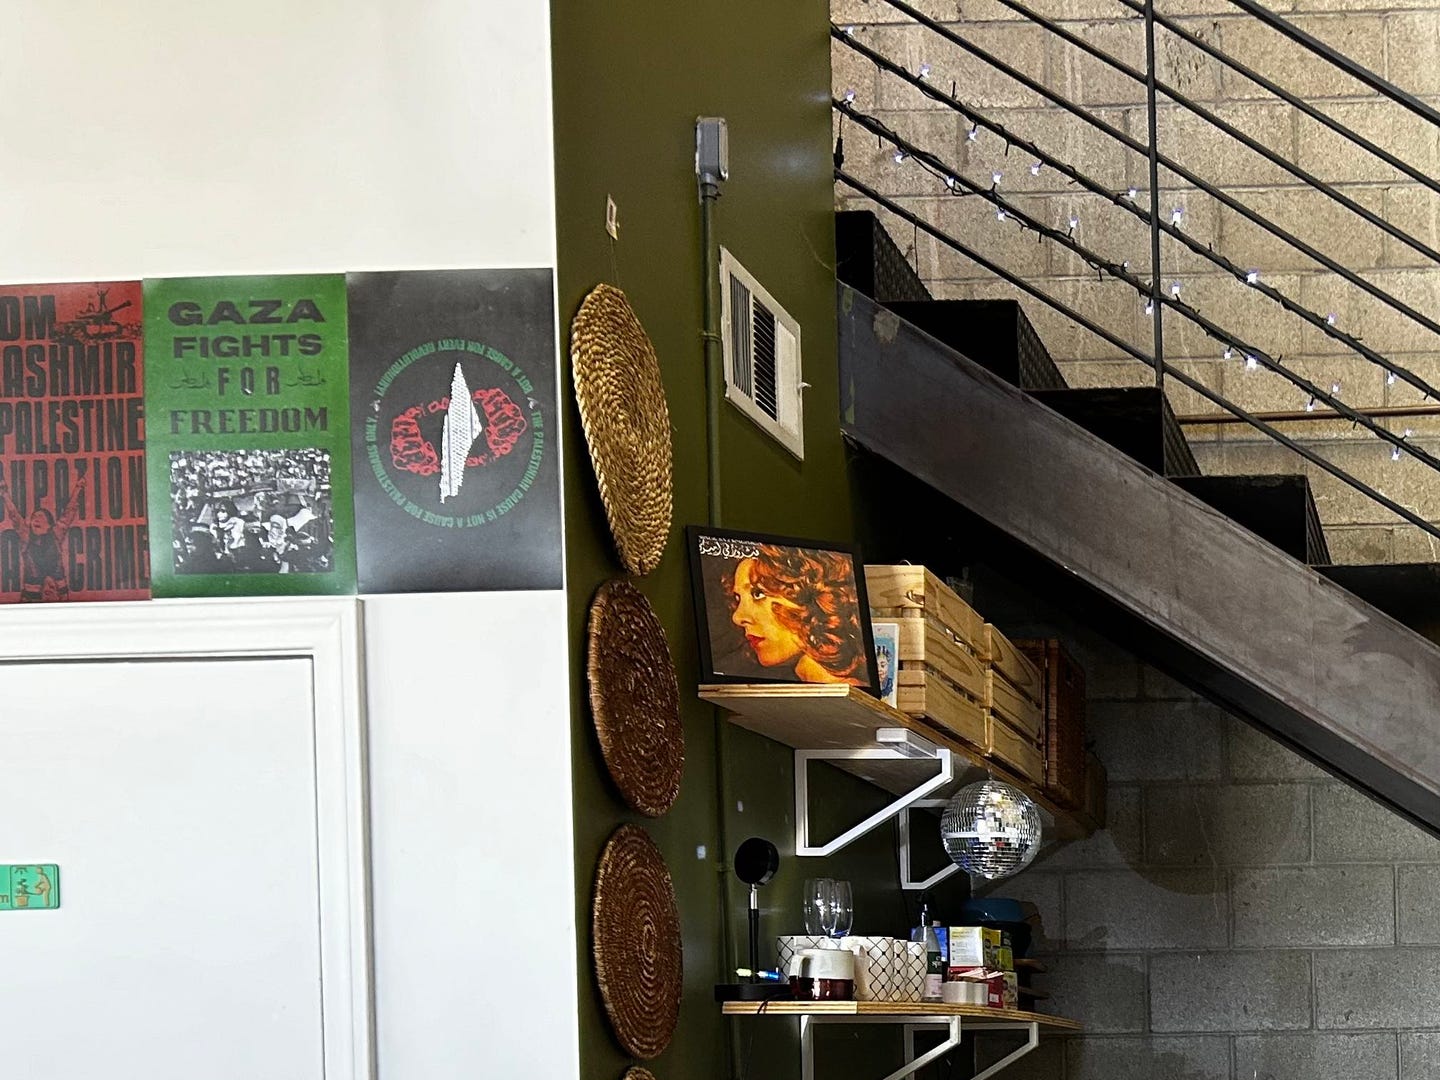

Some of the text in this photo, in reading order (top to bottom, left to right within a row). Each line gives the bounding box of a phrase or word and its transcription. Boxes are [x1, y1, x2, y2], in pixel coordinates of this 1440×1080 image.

[168, 298, 326, 327] GAZA
[173, 334, 322, 359] FIGHTS
[0, 341, 137, 398] ASHMIR
[218, 366, 280, 396] FOR
[169, 406, 328, 434] FREEDOM
[0, 455, 145, 521] UPATION
[495, 488, 523, 515] CAUSE
[422, 510, 454, 528] CAUSE
[456, 517, 463, 528] A
[467, 513, 485, 527] NOT
[485, 508, 497, 521] IS
